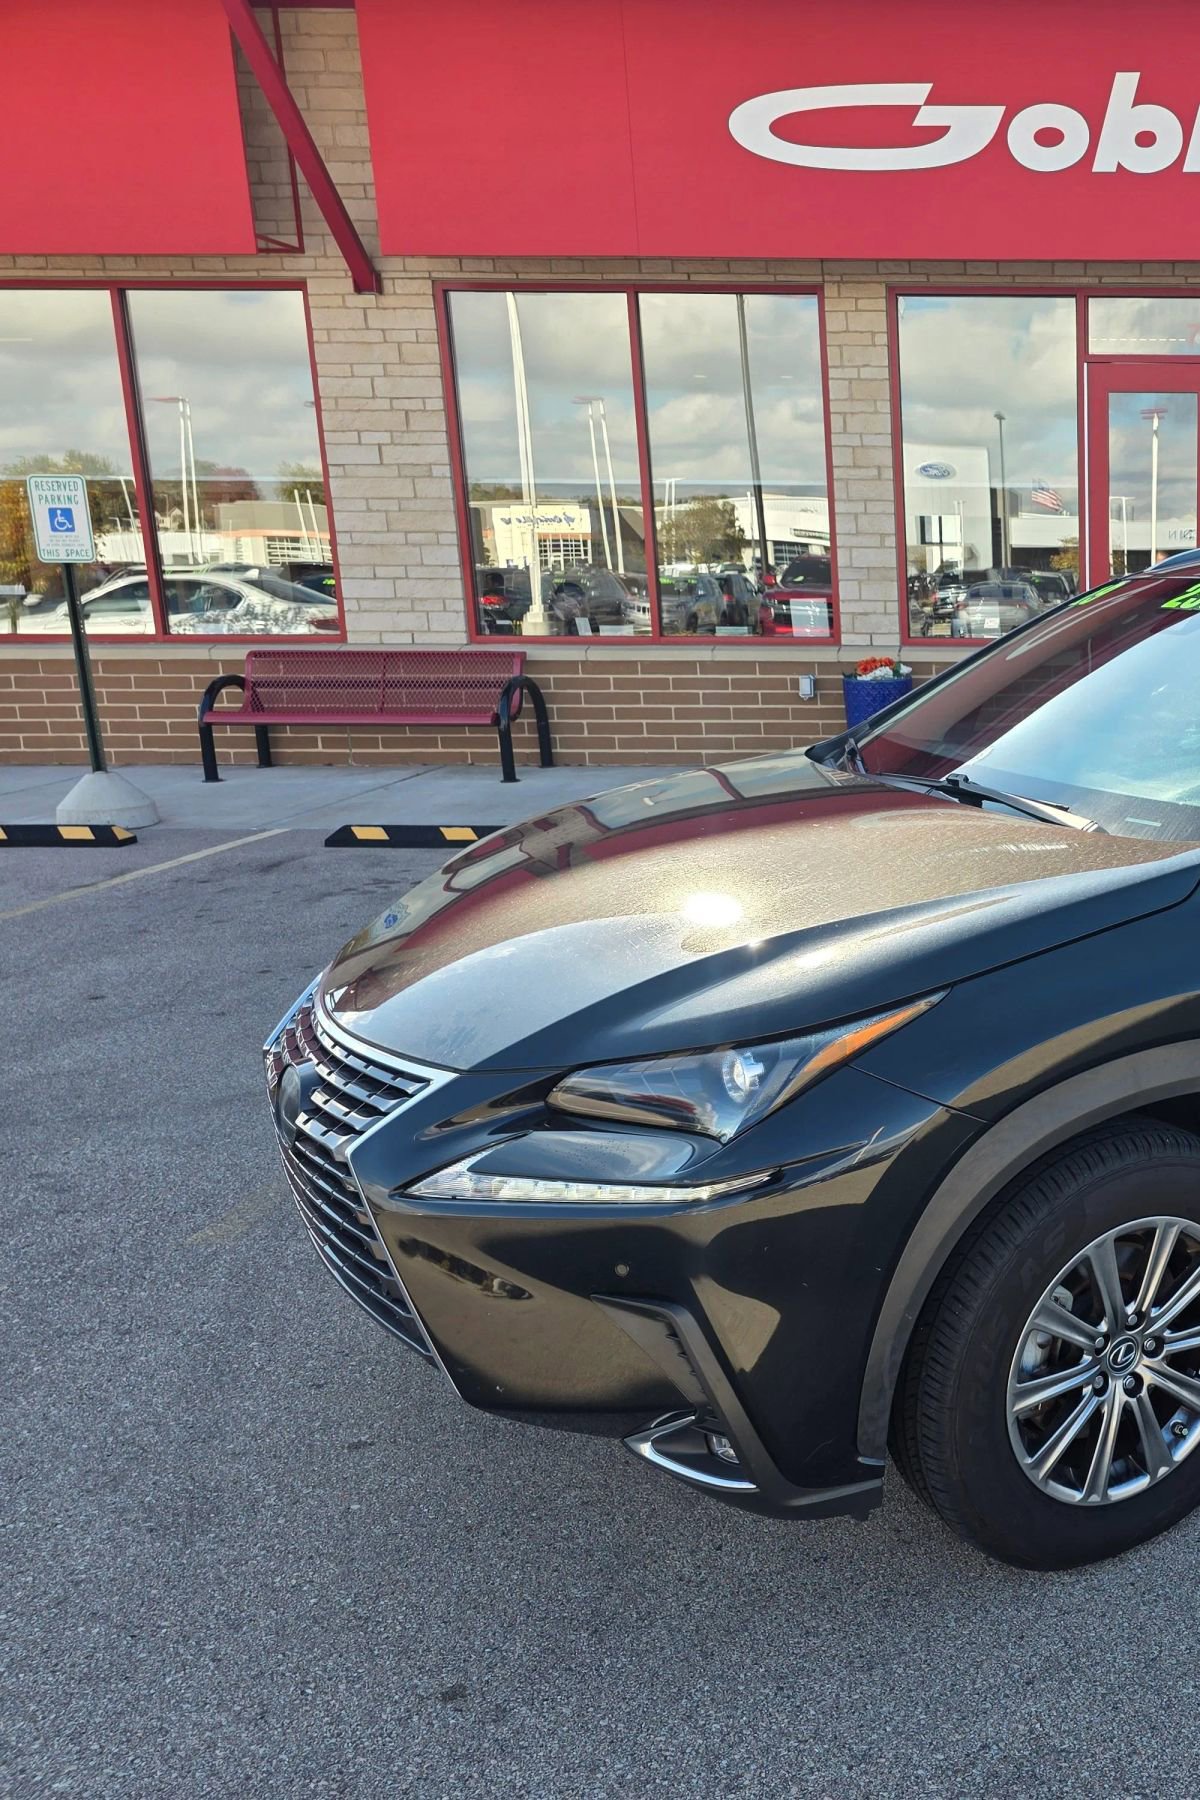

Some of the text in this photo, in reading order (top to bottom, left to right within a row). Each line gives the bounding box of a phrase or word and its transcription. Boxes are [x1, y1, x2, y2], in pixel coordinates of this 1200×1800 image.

[34, 481, 79, 492] RESERVED
[38, 494, 79, 505] PARKING
[42, 548, 90, 558] THIS SPACE
